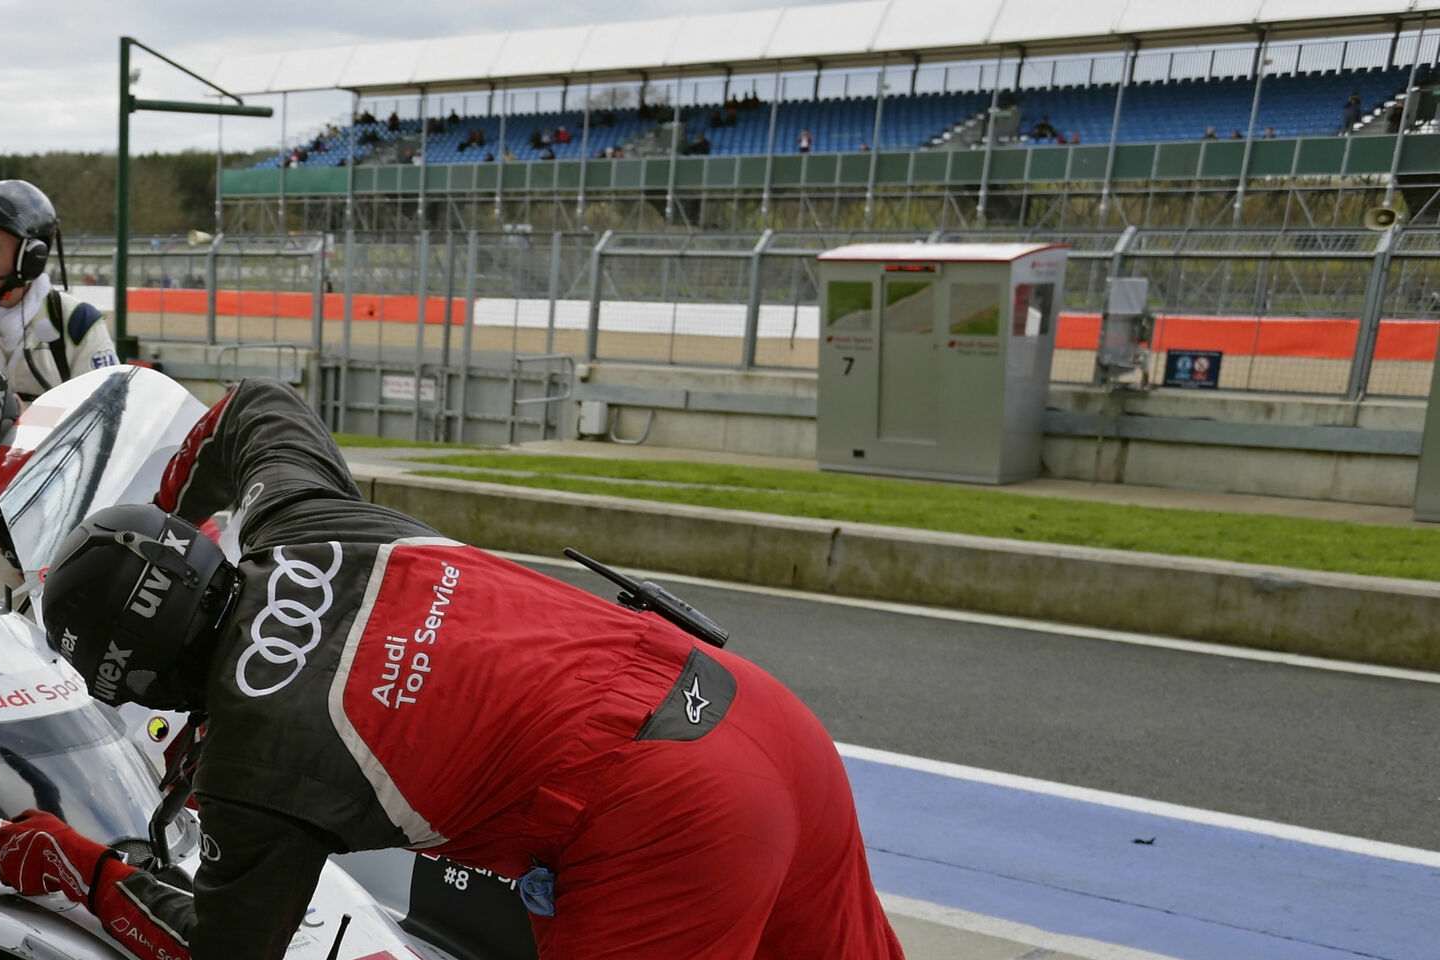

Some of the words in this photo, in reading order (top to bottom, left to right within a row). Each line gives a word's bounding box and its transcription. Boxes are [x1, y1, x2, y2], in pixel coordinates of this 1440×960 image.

[842, 356, 855, 376] 7
[130, 529, 191, 618] uvx
[93, 640, 134, 701] uvex
[372, 635, 408, 708] Audi
[394, 652, 432, 709] Top
[443, 866, 470, 891] #8
